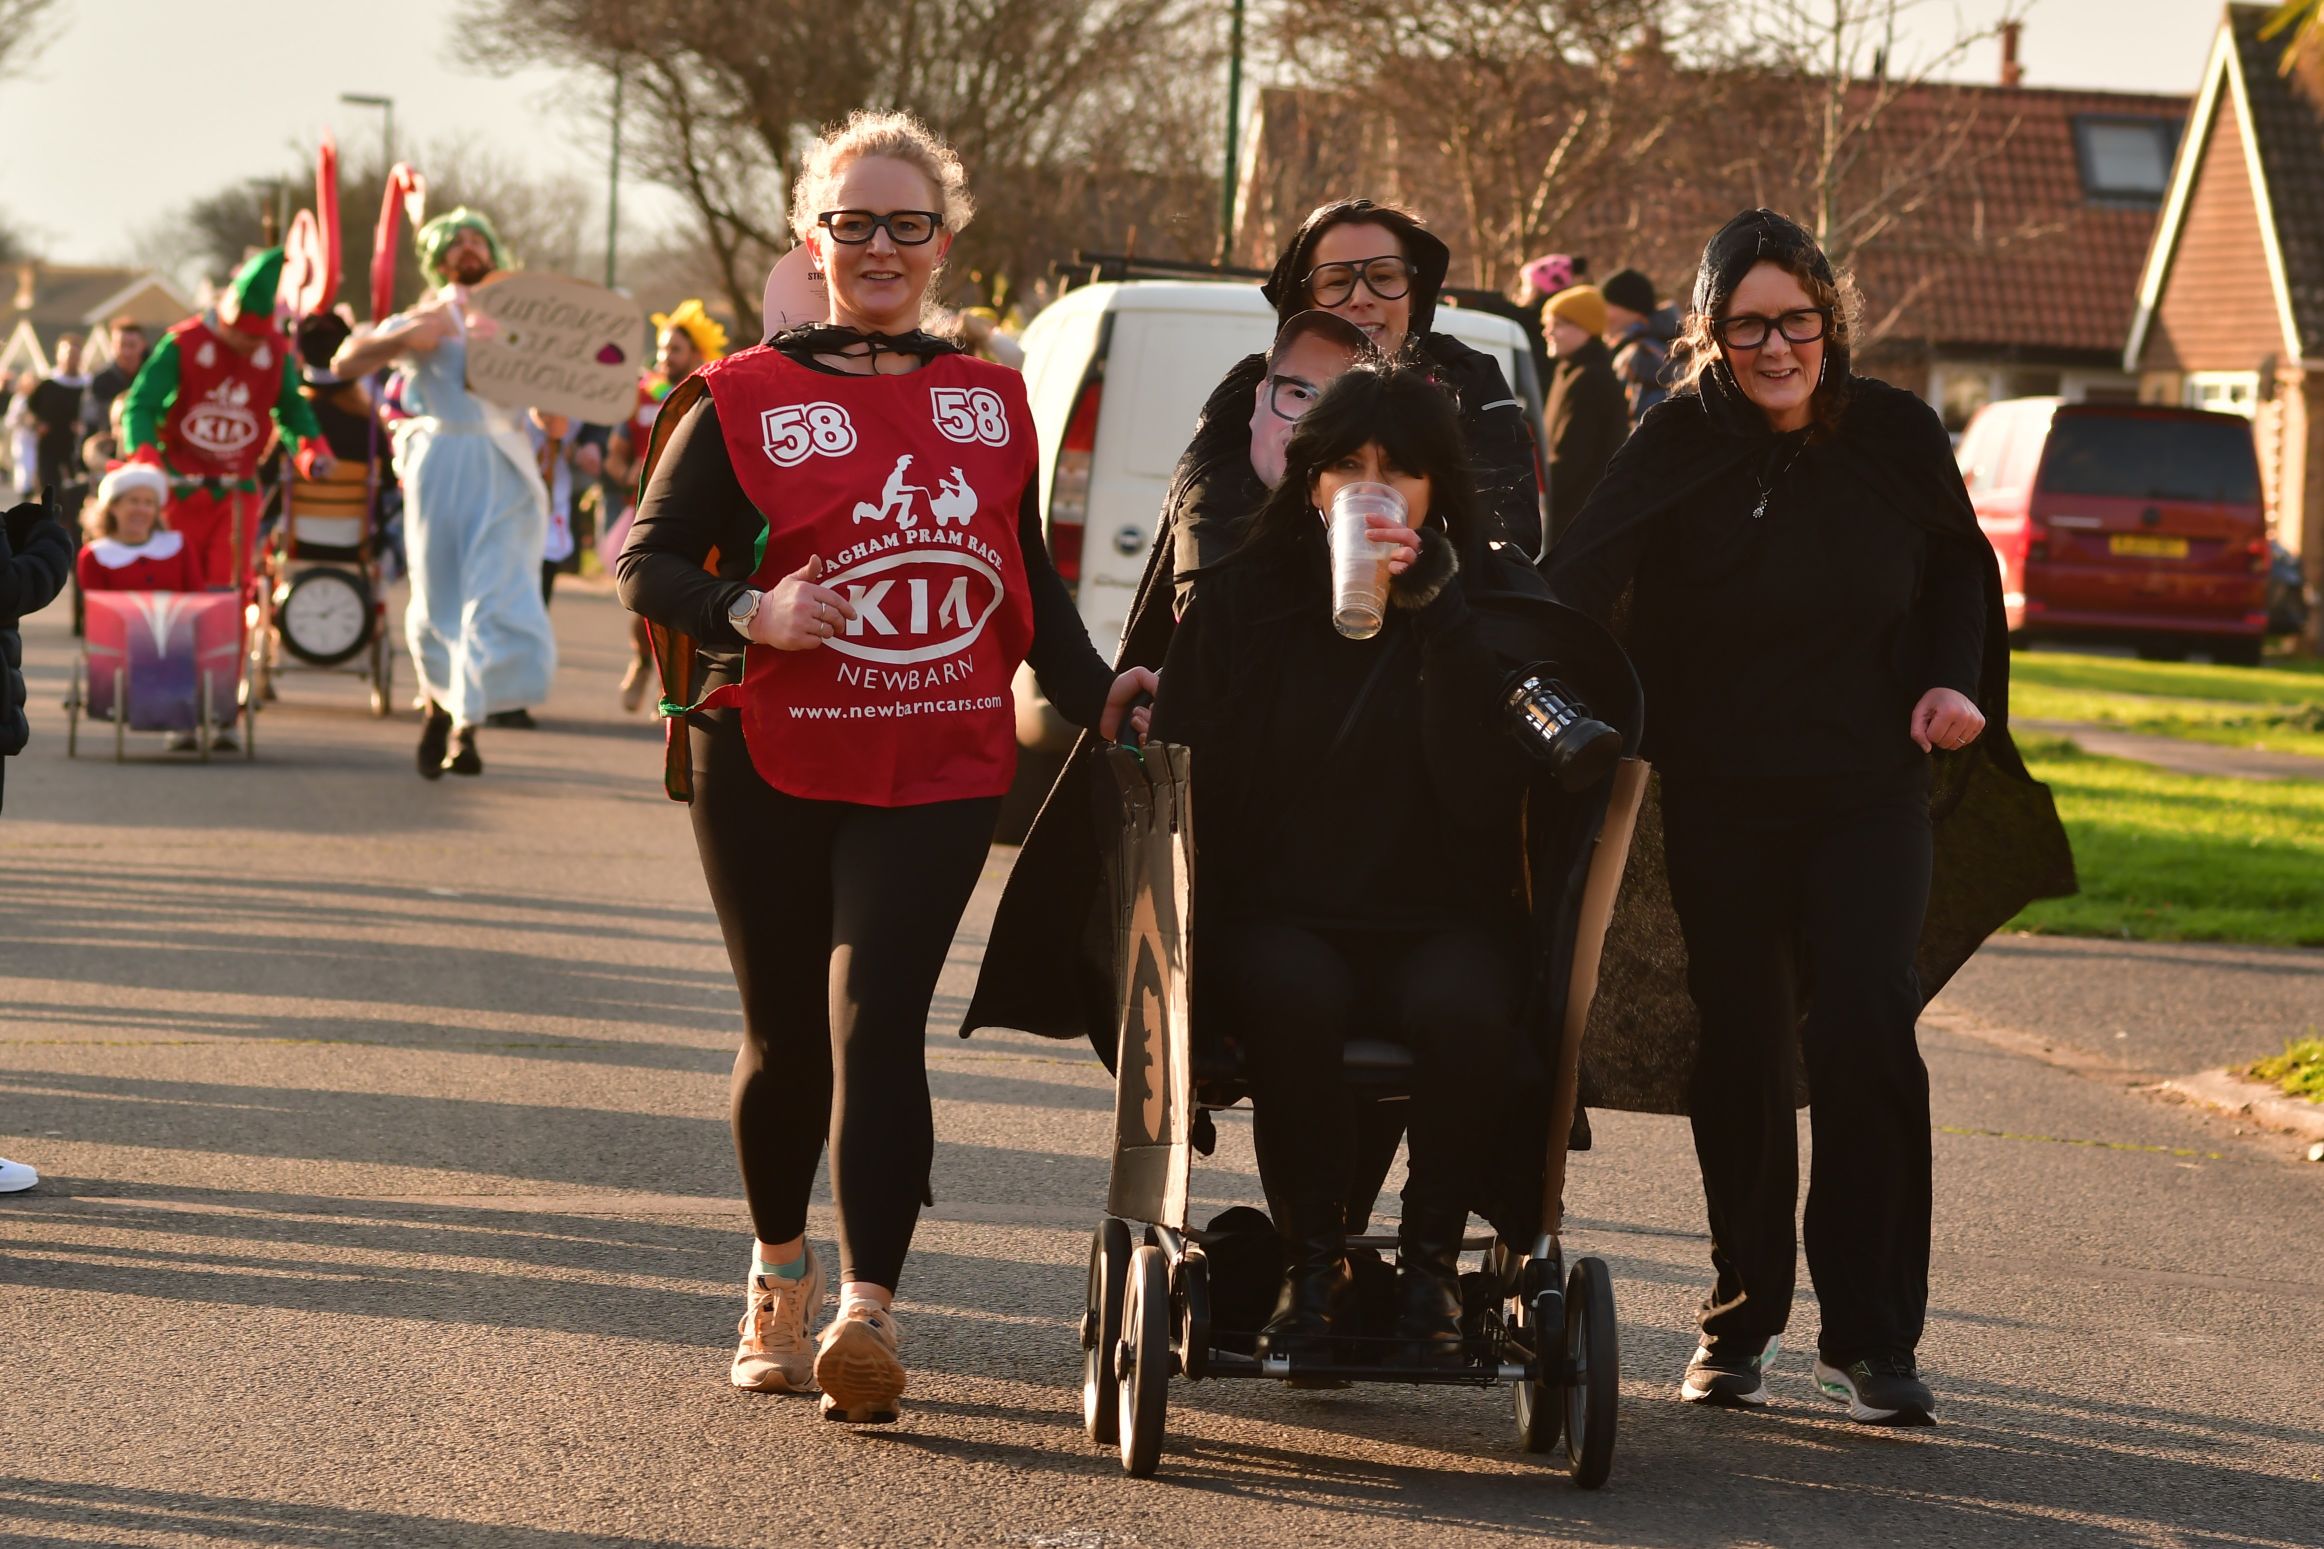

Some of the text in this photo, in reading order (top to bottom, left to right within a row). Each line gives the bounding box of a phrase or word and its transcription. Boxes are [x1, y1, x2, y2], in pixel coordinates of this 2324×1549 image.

[194, 417, 245, 441] KIA
[760, 401, 858, 468] 58
[930, 386, 1009, 448] 58
[817, 528, 1003, 578] AGHAM PRAM RACE
[845, 576, 974, 636] KIA
[836, 653, 974, 692] NEWBARN
[788, 695, 1002, 719] www.newbarncars.com
